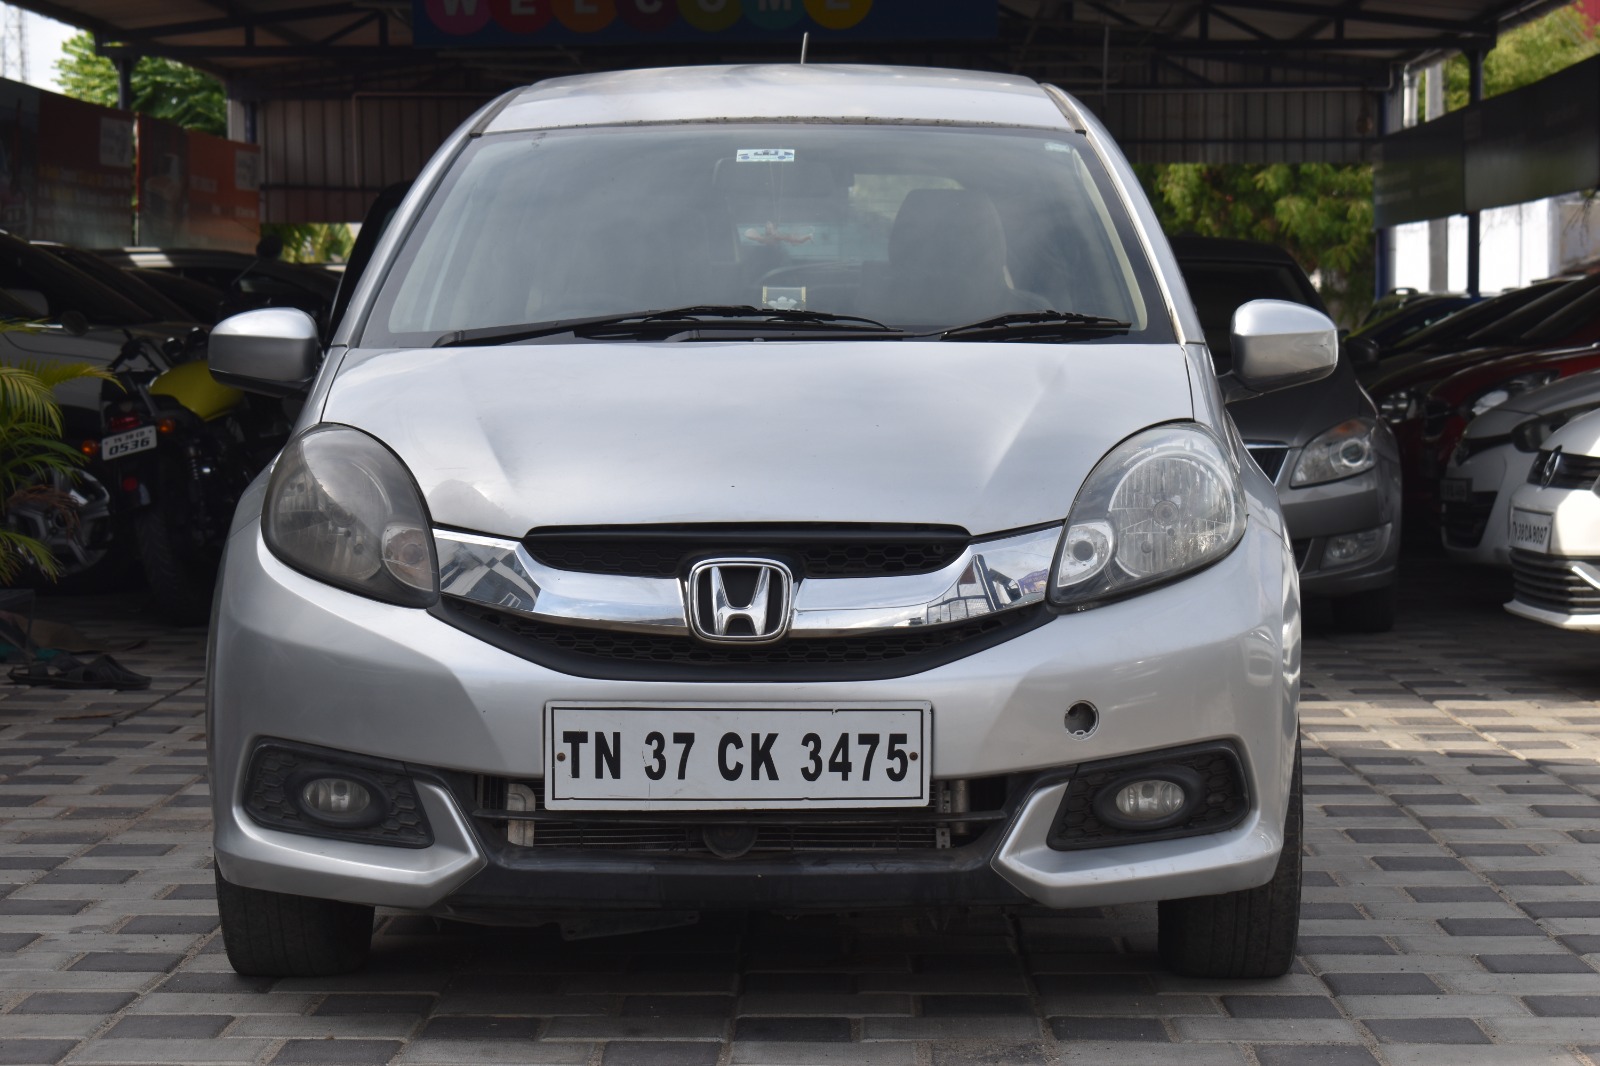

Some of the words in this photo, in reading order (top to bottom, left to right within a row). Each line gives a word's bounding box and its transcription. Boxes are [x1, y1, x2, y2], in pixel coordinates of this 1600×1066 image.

[109, 437, 150, 456] 0536
[562, 730, 621, 780] TN
[643, 731, 695, 781] 37
[717, 731, 780, 782] CK
[800, 732, 909, 782] 3475
